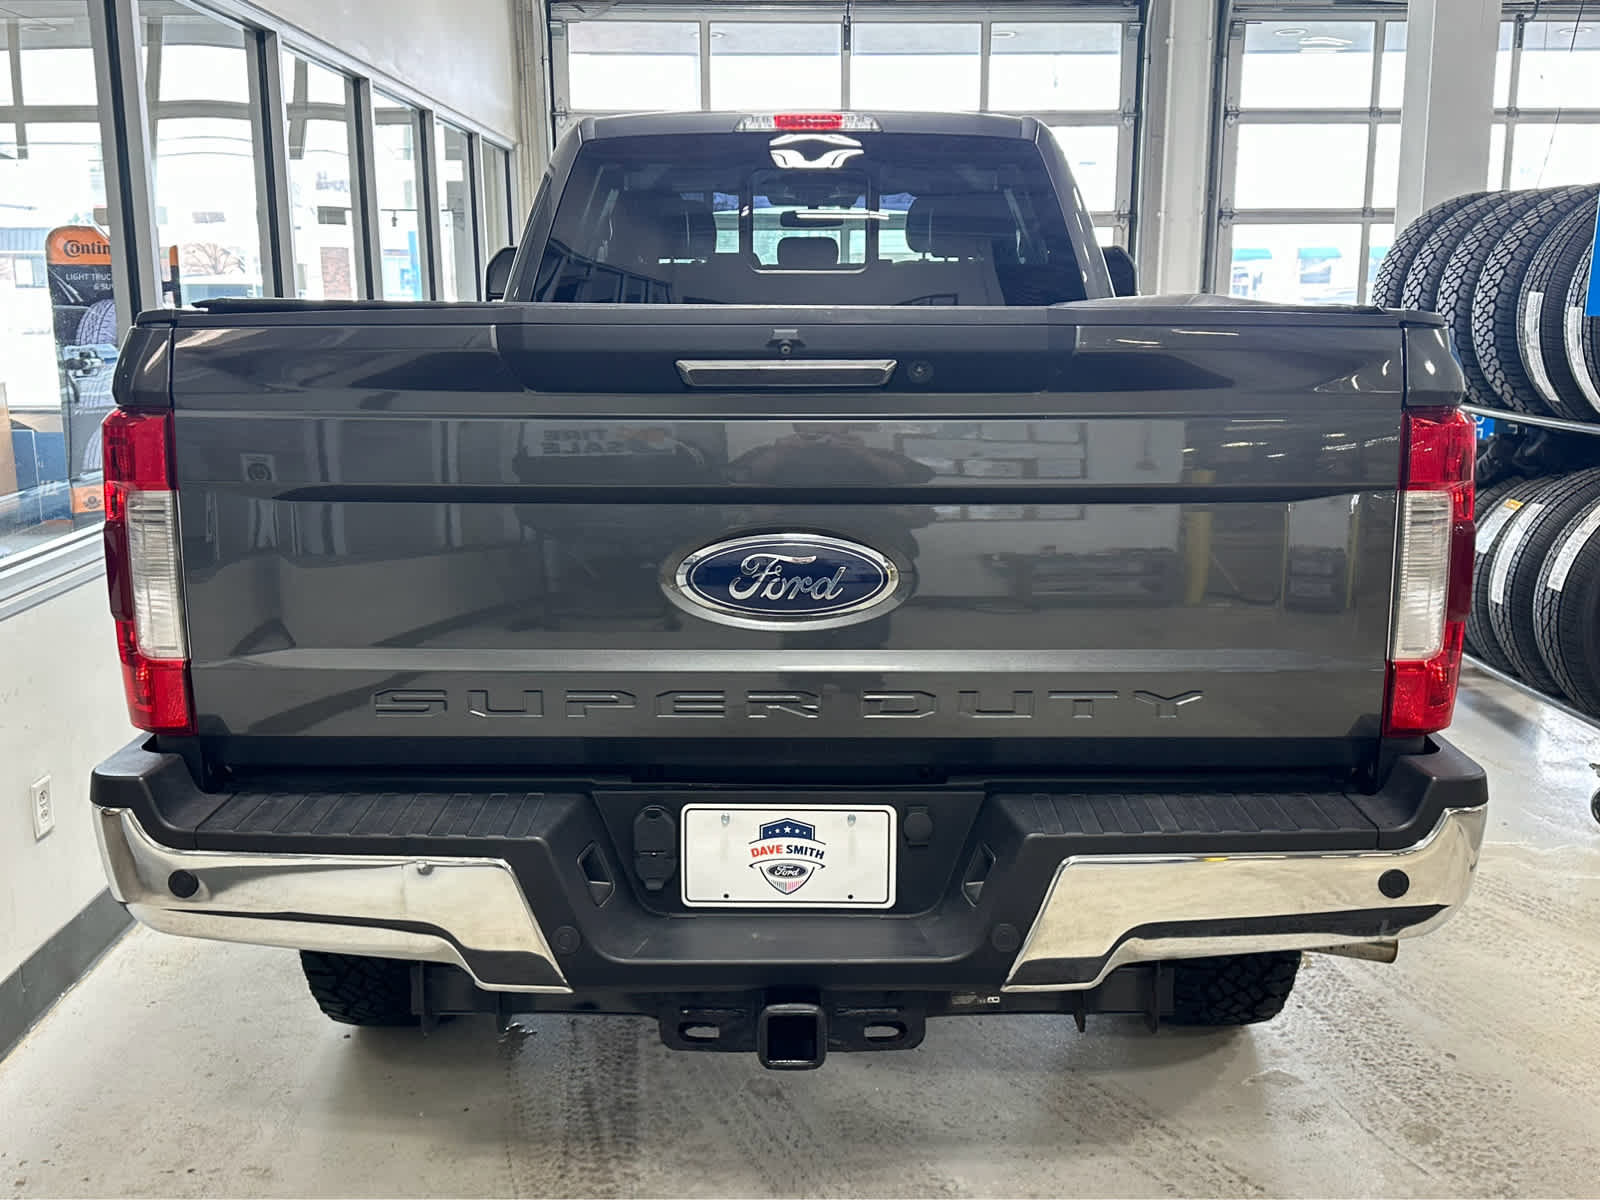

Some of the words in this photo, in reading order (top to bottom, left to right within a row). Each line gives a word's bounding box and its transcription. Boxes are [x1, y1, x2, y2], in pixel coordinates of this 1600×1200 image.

[64, 240, 110, 257] Contin
[65, 273, 89, 281] LIGHT
[728, 553, 847, 601] Ford
[374, 689, 820, 719] SUPER
[862, 689, 1204, 719] DUTY
[750, 844, 784, 858] DAVE
[785, 844, 825, 860] SMITH
[774, 865, 801, 877] Ford
